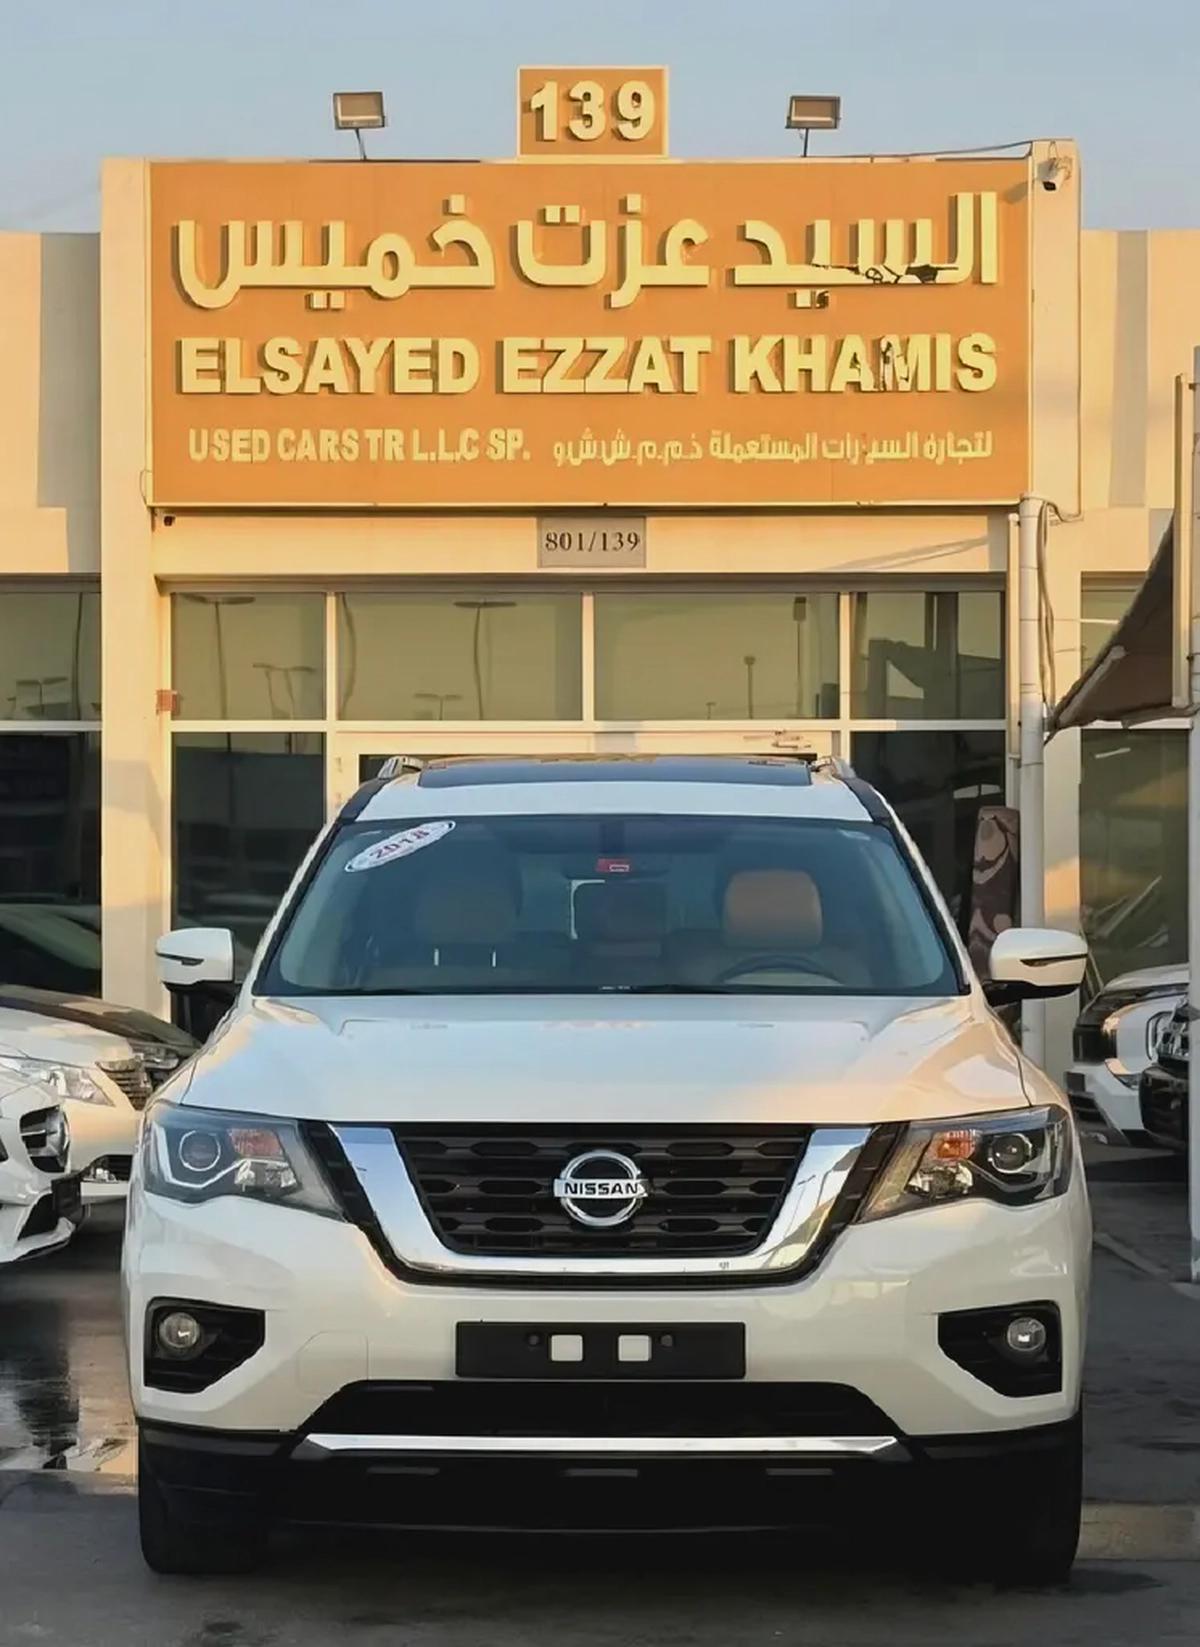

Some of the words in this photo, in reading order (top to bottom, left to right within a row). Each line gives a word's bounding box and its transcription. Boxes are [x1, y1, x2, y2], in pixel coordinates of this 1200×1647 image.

[530, 80, 655, 141] 139
[177, 194, 495, 310] خميس
[515, 194, 709, 308] عزت
[733, 191, 997, 308] السيد
[180, 337, 481, 395] ELSAYED
[502, 336, 712, 394] EZZAT
[732, 332, 998, 393] KHAMIS
[188, 428, 271, 463] USED
[277, 428, 360, 462] CARS
[364, 428, 406, 462] TR
[412, 428, 480, 462] L.L.C
[485, 428, 532, 462] SP.
[709, 429, 818, 464] المستعملة
[821, 431, 920, 466] السيرات
[544, 531, 641, 552] 801/139
[564, 1182, 639, 1195] NISSAN
